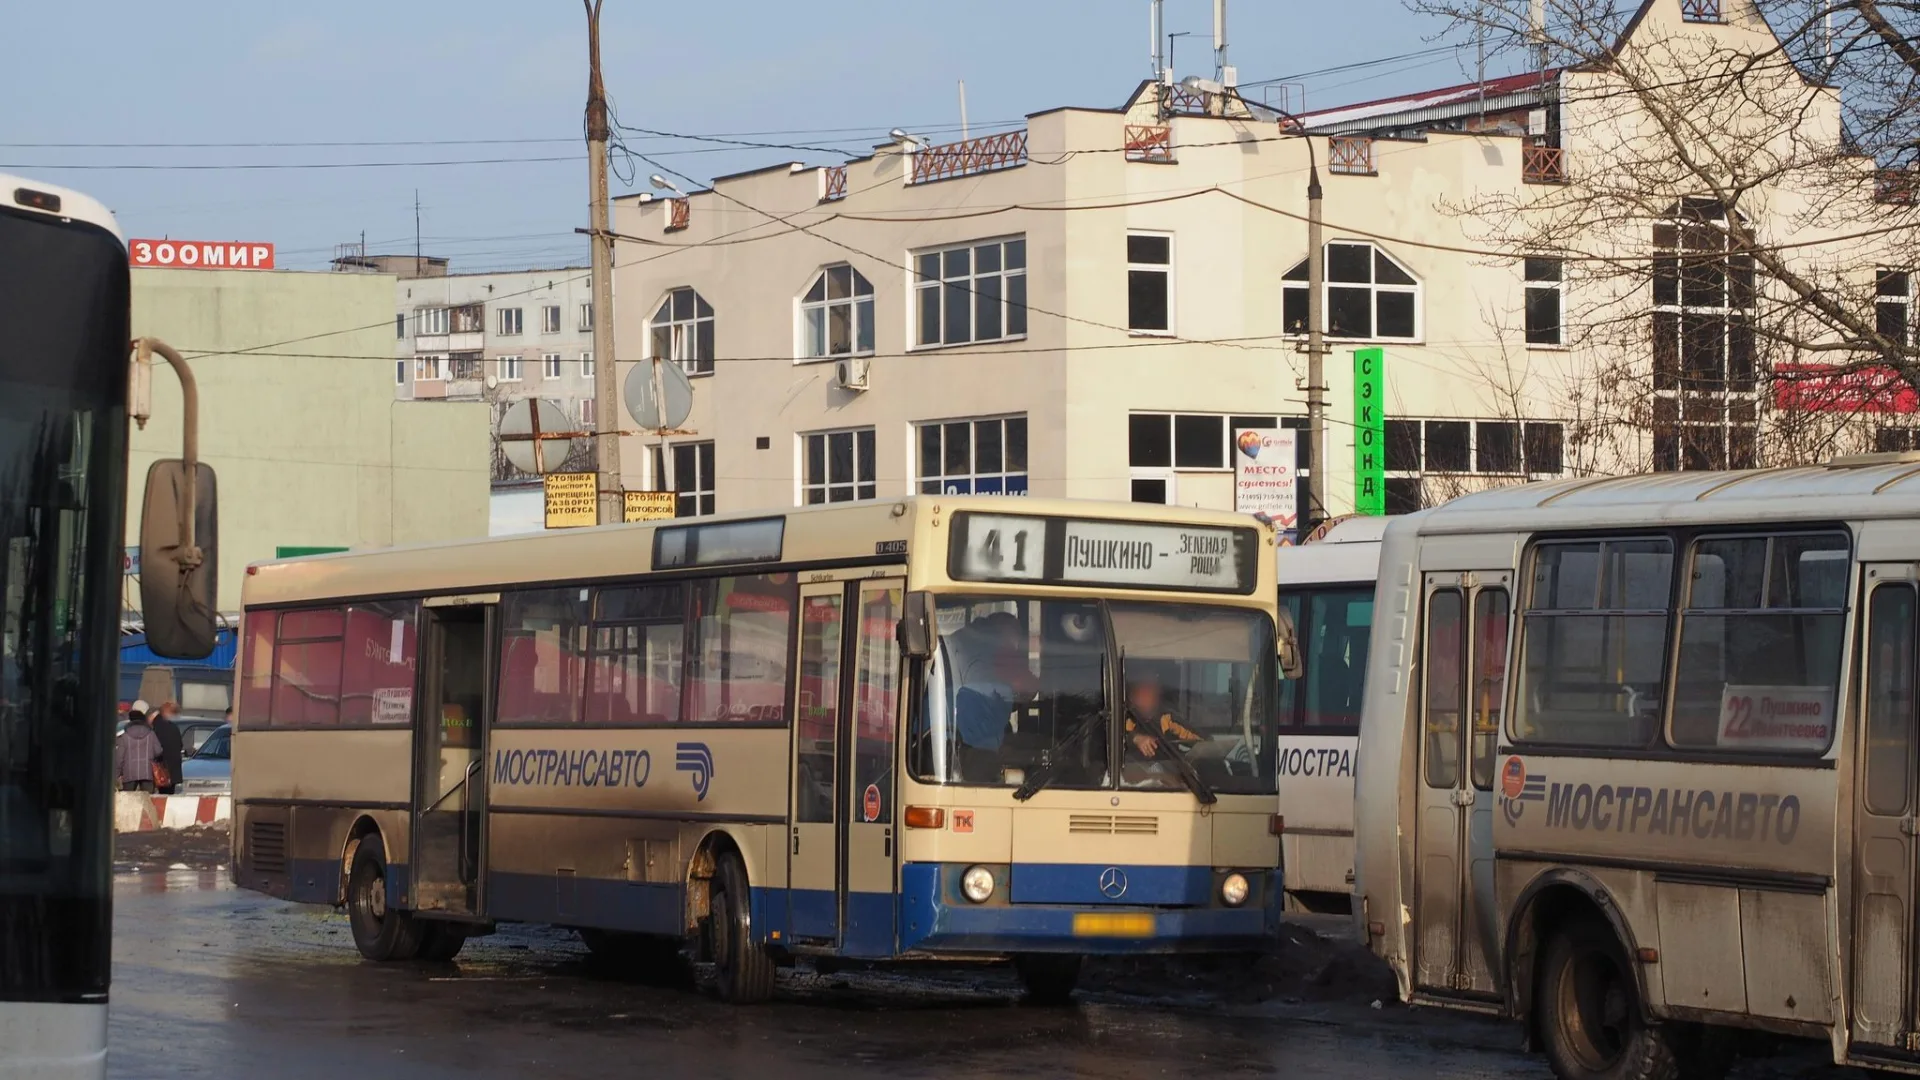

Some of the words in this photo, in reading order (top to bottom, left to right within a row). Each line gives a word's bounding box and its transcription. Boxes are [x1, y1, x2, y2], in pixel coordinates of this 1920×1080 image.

[135, 242, 269, 267] ЗООМИР
[1361, 358, 1374, 497] СЭКОНД
[1244, 466, 1287, 474] МЕСТО
[546, 506, 594, 514] АВТОБУСА
[627, 493, 672, 501] СТОЯНКА
[885, 540, 906, 552] 405
[980, 528, 1028, 571] 41
[1067, 534, 1153, 570] ПУШКИНО
[1724, 695, 1753, 738] 22
[1761, 697, 1821, 717] Пушкино
[493, 749, 650, 788] МОСТРАНСАВТО
[954, 816, 973, 828] ТК
[1545, 782, 1801, 846] МОСТРАНСАВТО
